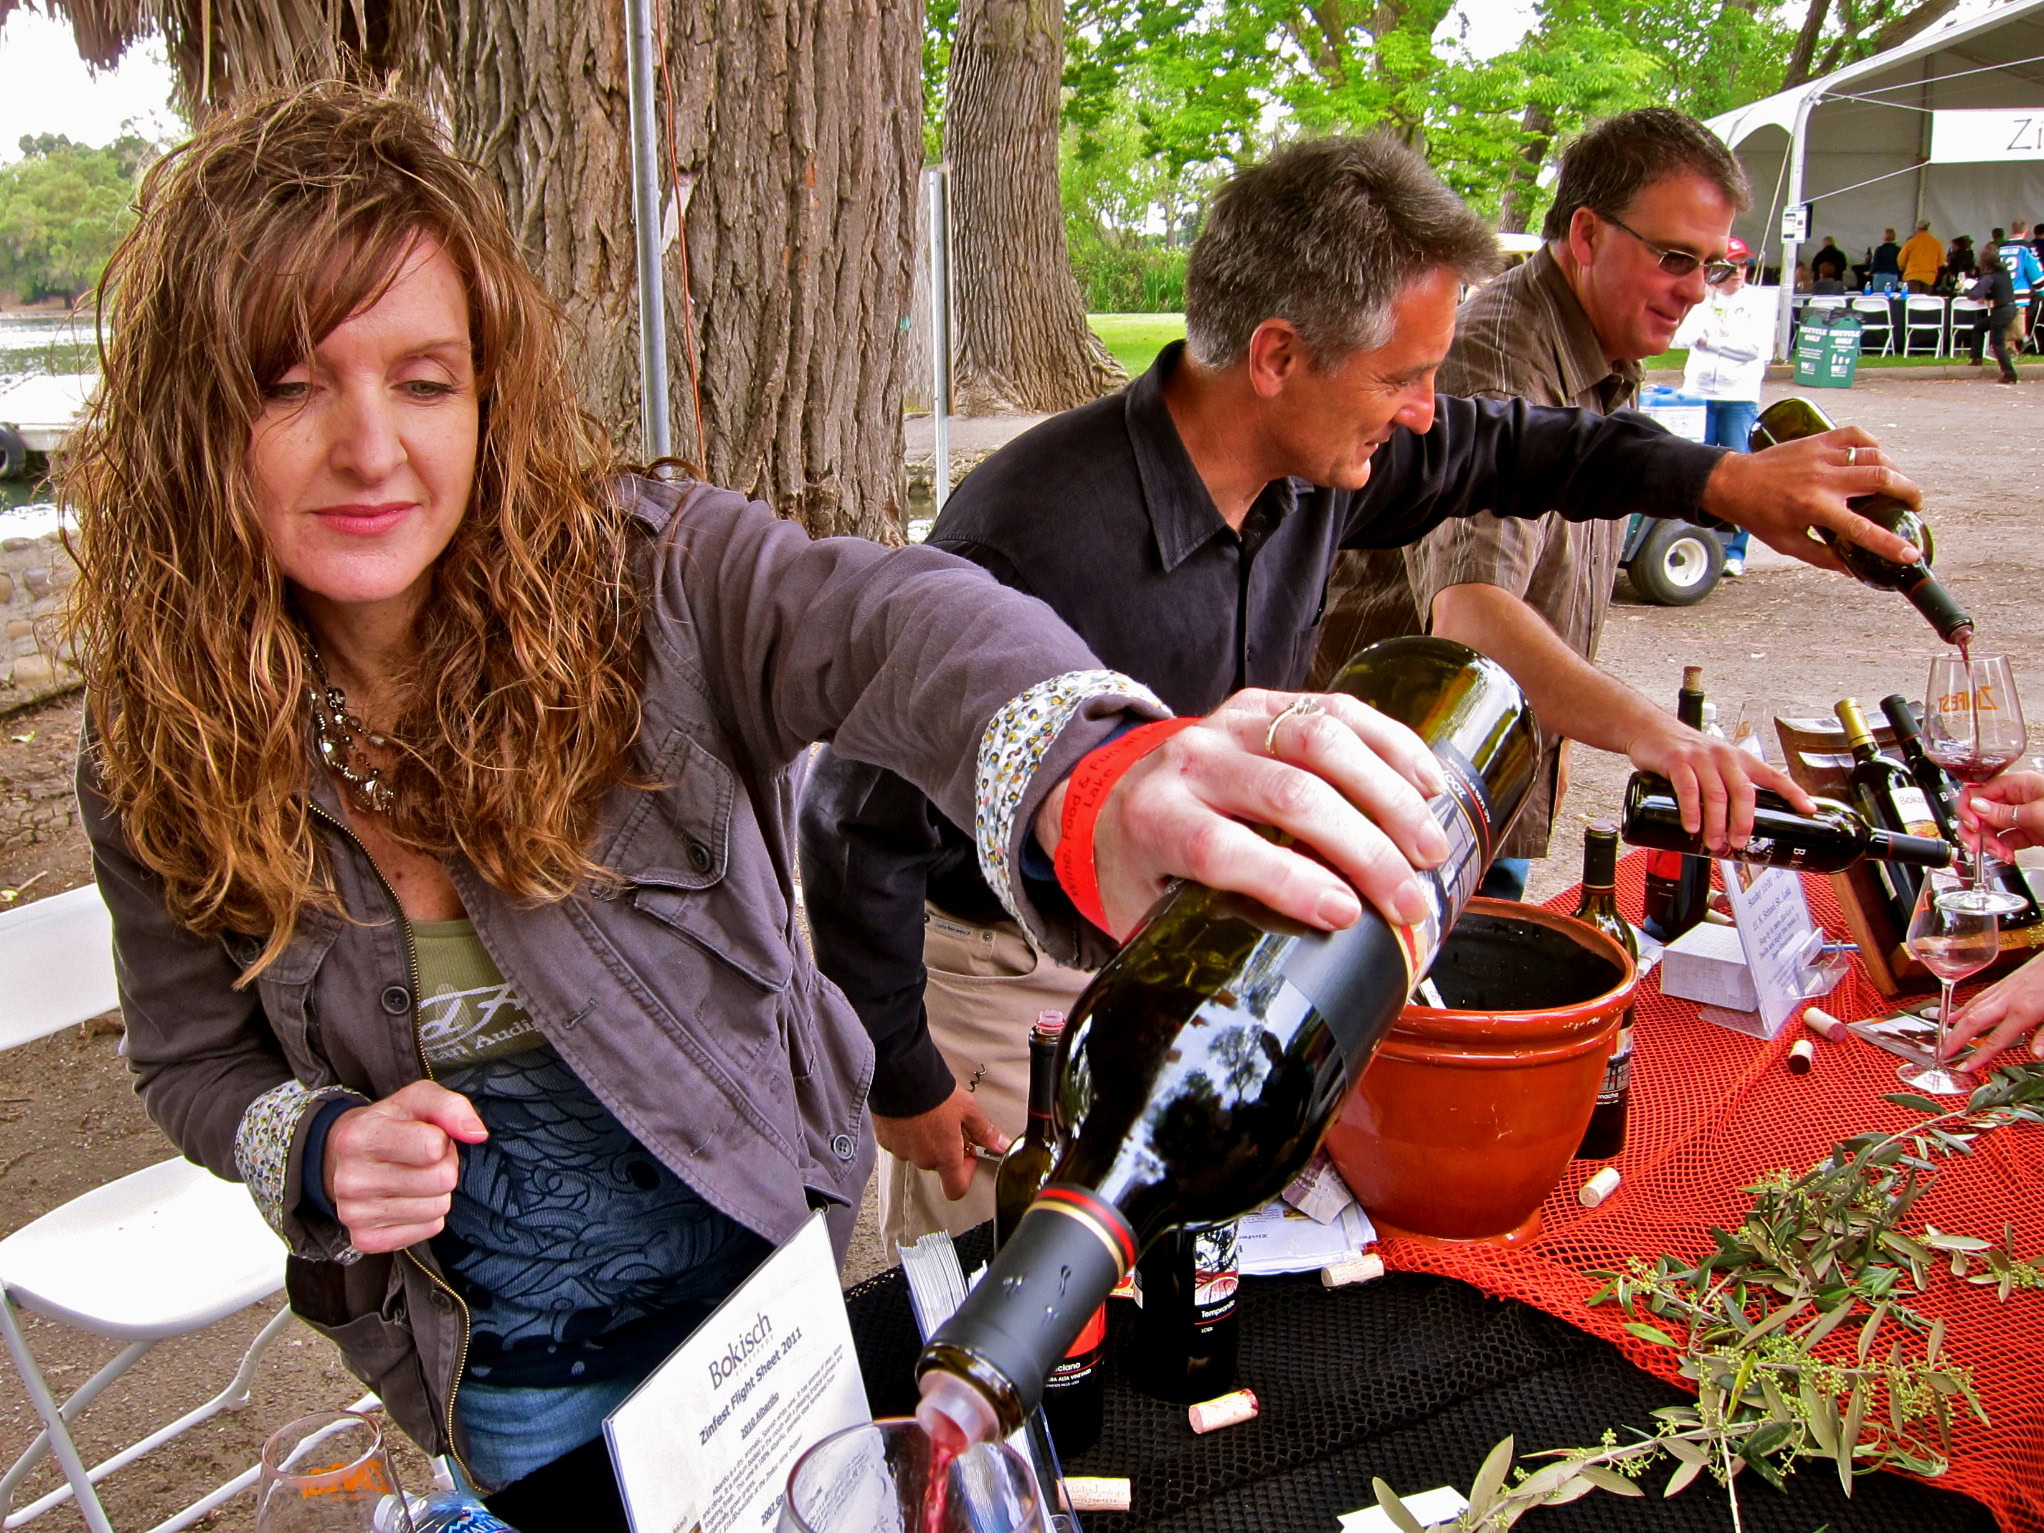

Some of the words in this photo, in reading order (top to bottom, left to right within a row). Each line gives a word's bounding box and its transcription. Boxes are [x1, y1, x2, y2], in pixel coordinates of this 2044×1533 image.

[1062, 795, 1082, 840] Food
[1078, 776, 1091, 790] &
[1090, 747, 1116, 771] Fun
[1084, 768, 1114, 809] Lake
[699, 1404, 732, 1446] Zinfest
[730, 1376, 756, 1411] Flight
[755, 1349, 782, 1382] Sheet
[780, 1326, 803, 1355] 2011
[707, 1312, 773, 1391] Bokisch
[1055, 1362, 1081, 1372] ciano
